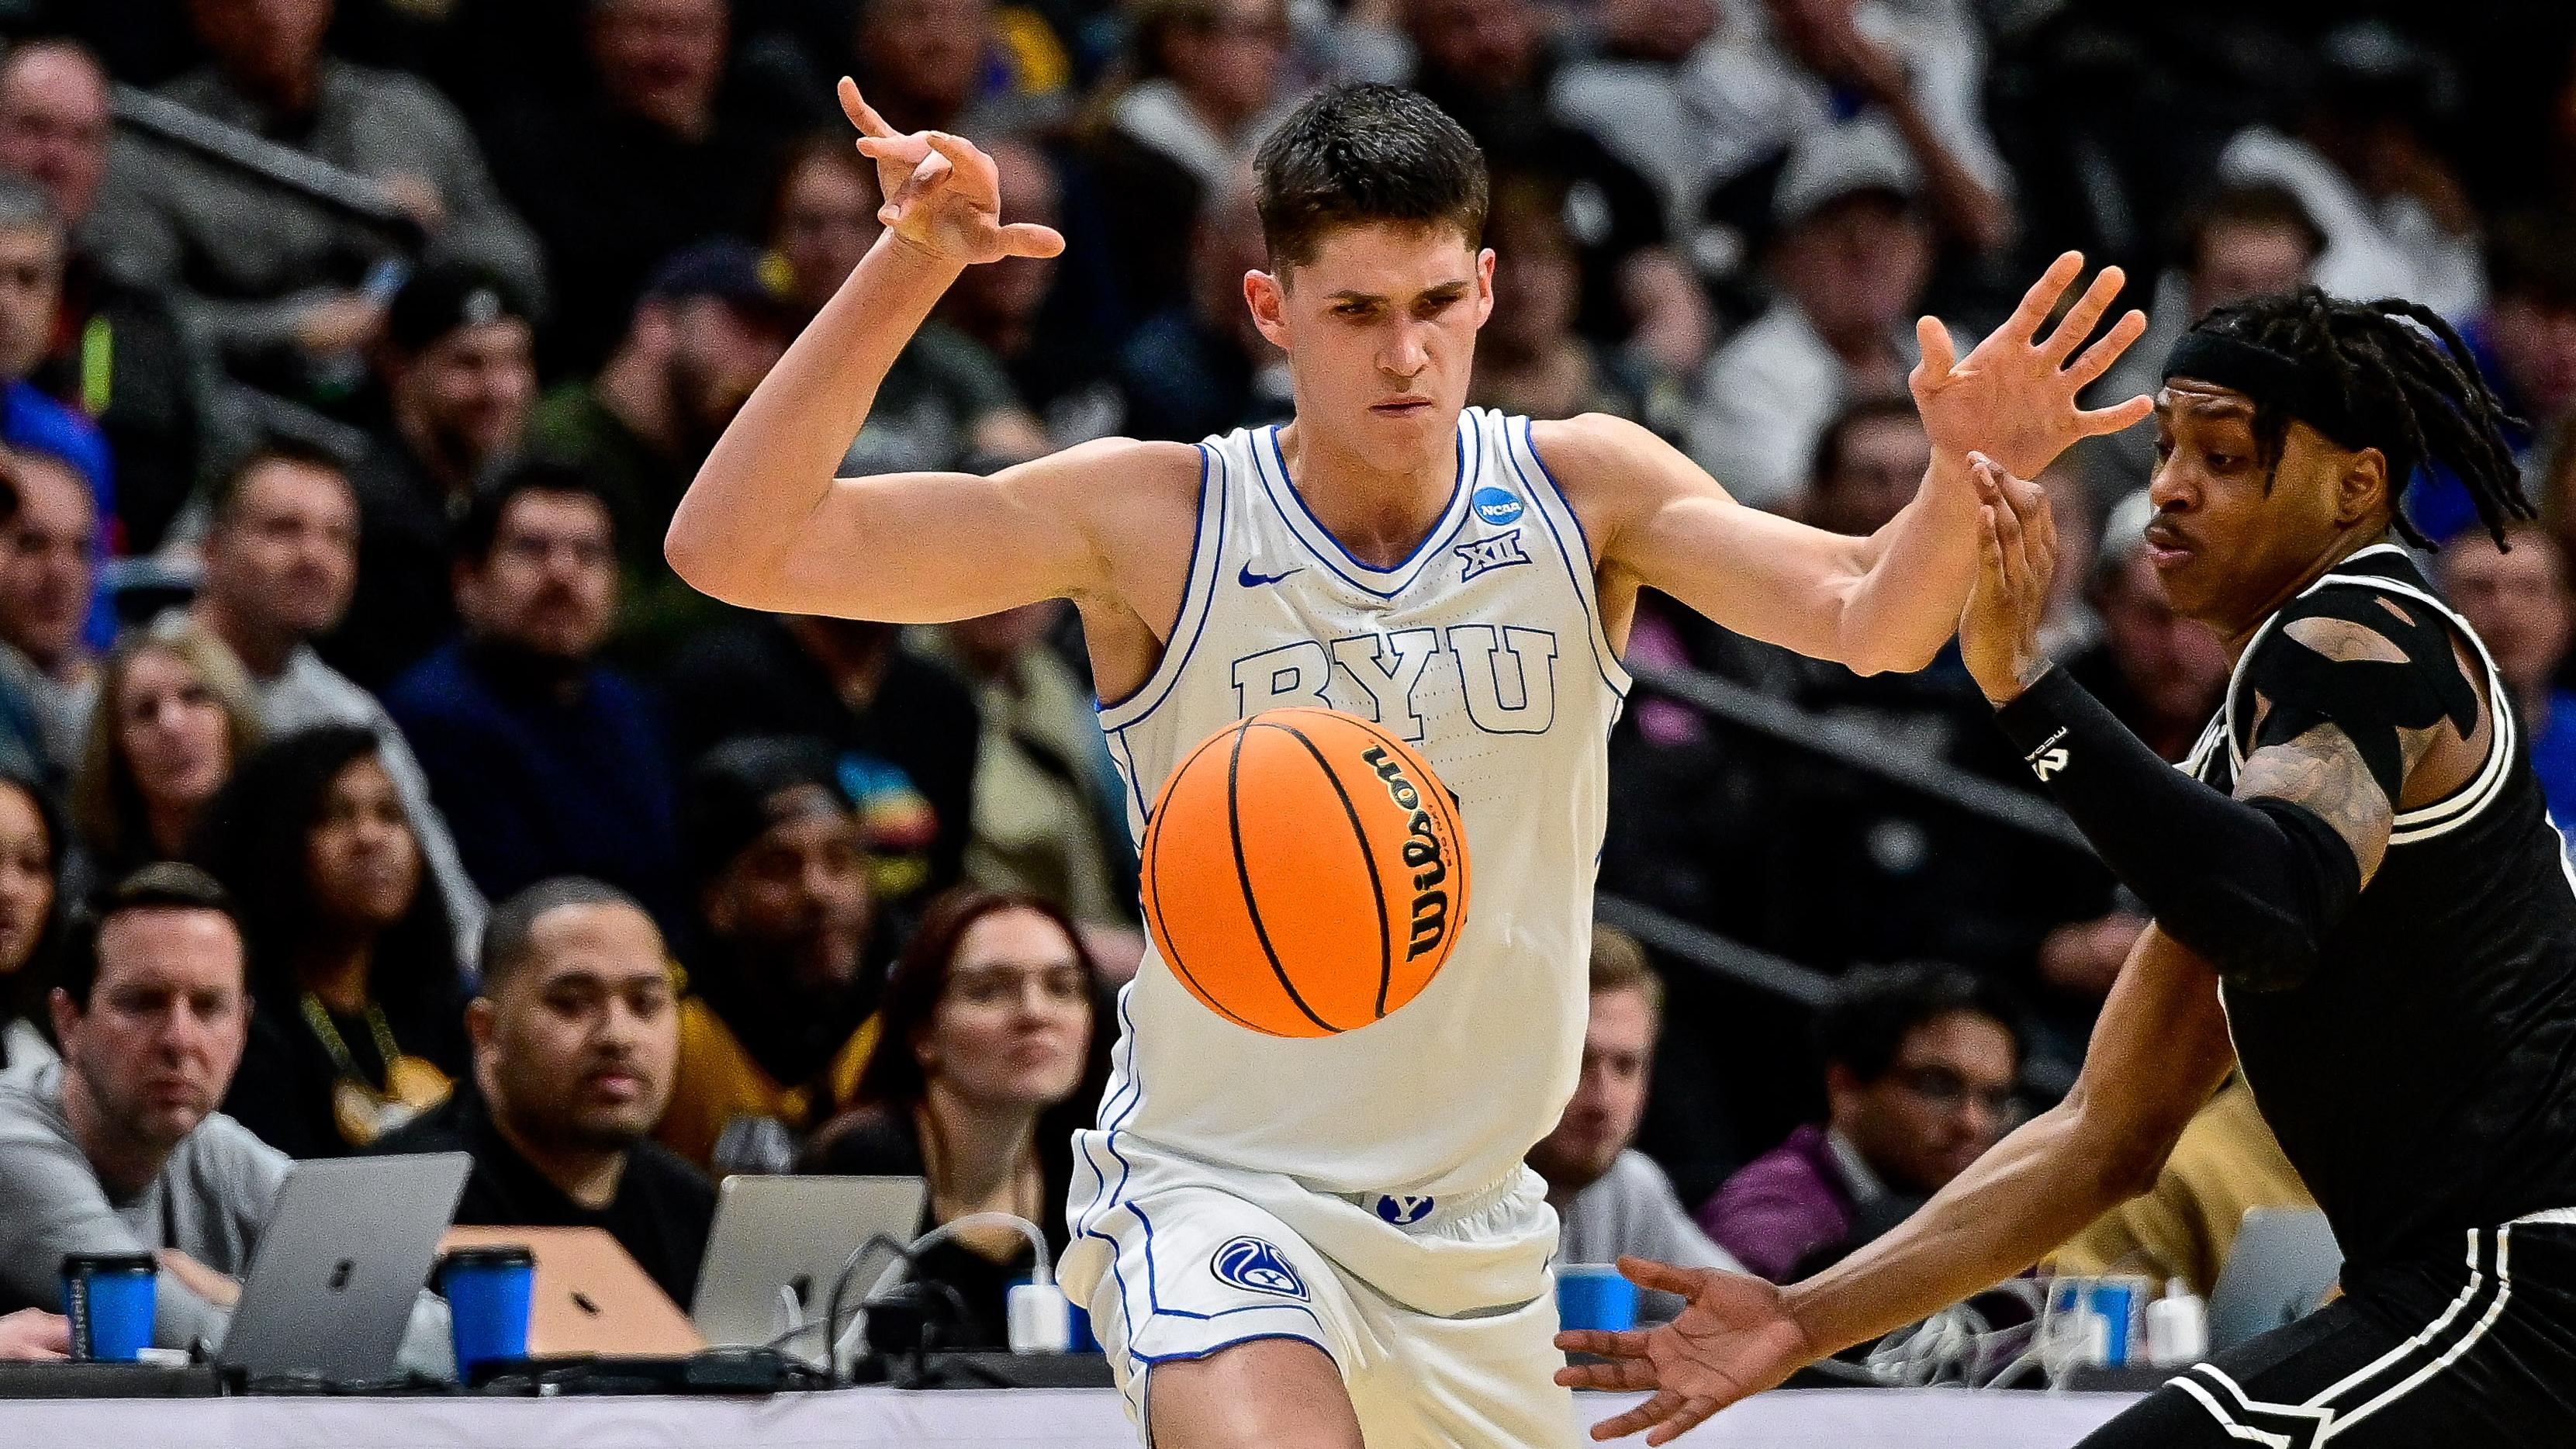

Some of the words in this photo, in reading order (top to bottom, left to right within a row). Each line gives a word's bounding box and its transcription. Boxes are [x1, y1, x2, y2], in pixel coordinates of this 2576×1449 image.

[1481, 502, 1522, 516] NCAA
[1453, 528, 1533, 583] XII
[1231, 624, 1557, 742] BYU
[1361, 744, 1447, 963] Wilson
